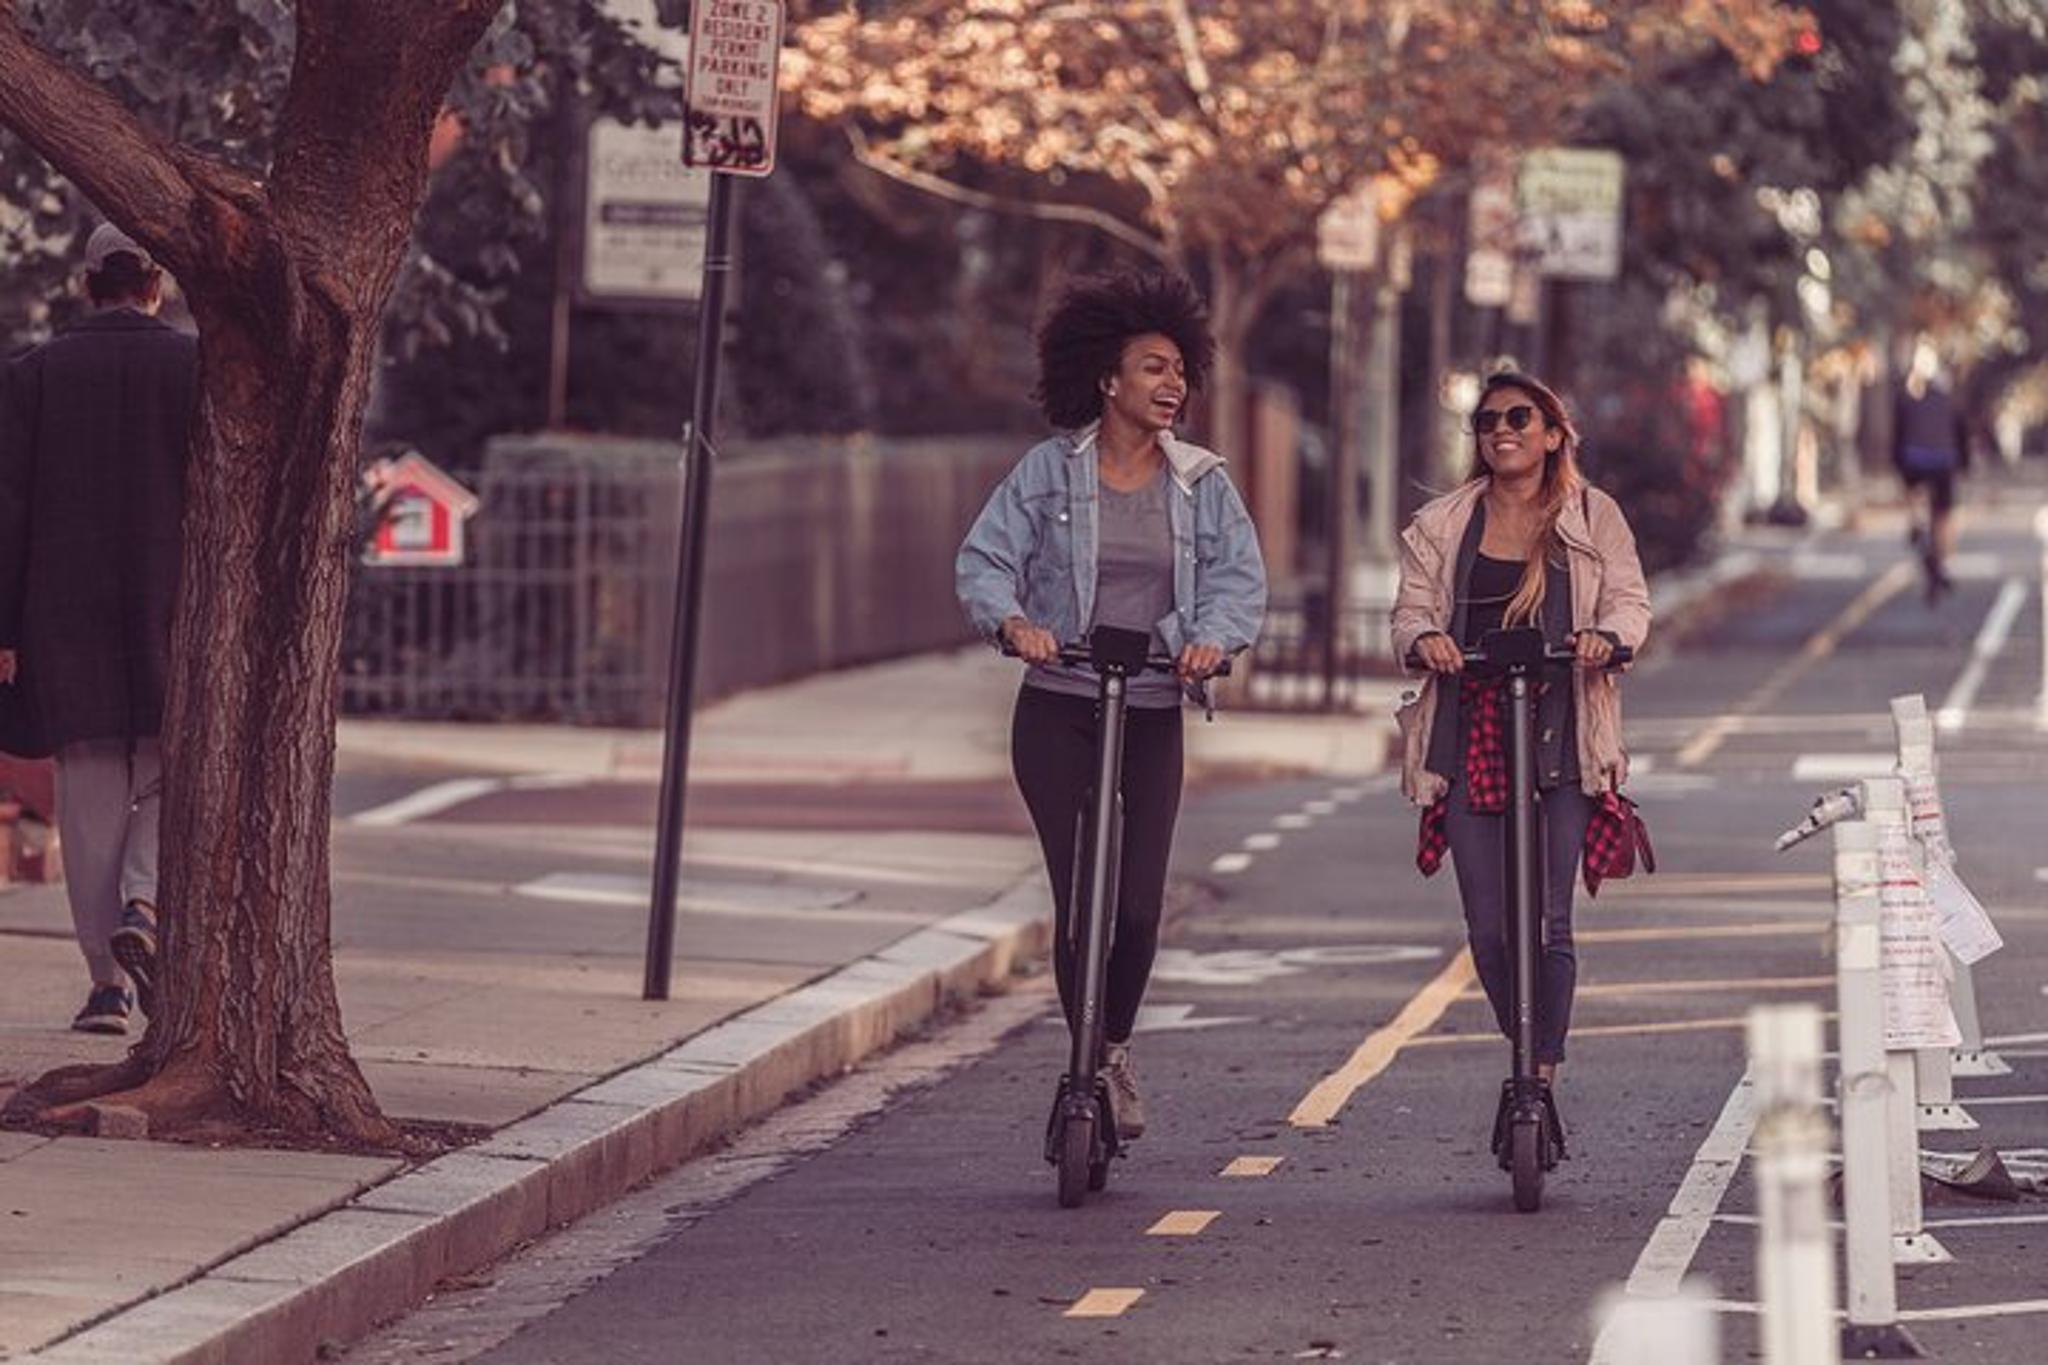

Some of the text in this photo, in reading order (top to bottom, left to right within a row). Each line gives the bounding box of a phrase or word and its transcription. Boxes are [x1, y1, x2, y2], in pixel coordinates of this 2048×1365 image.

[711, 0, 767, 23] ZONE 2
[702, 19, 771, 41] RESIDENT
[711, 39, 760, 60] PERMIT
[699, 55, 769, 80] PARKING
[716, 77, 749, 97] ONLY
